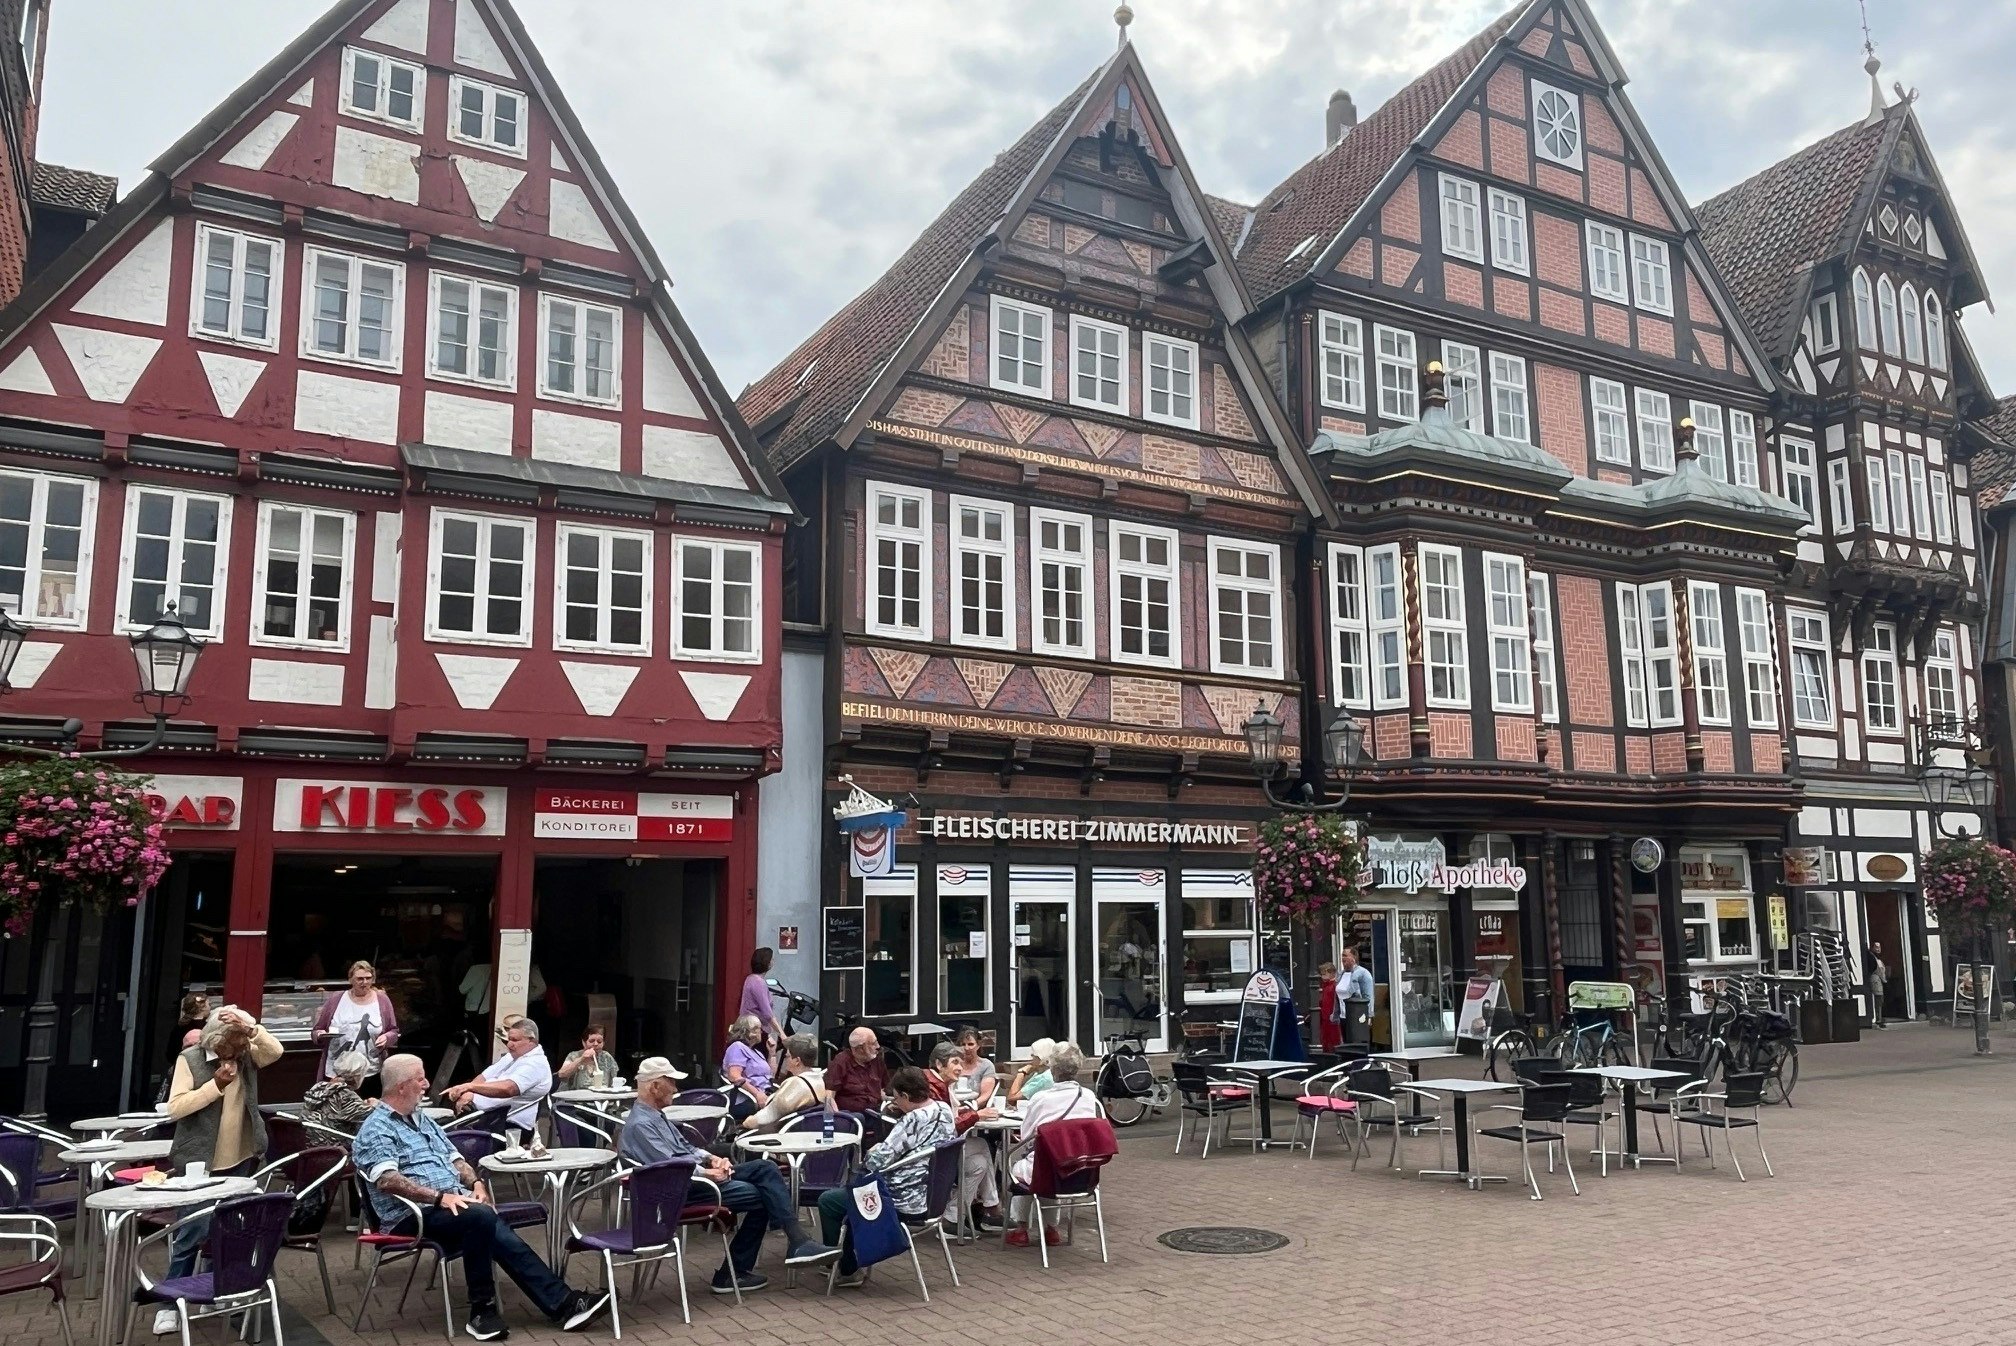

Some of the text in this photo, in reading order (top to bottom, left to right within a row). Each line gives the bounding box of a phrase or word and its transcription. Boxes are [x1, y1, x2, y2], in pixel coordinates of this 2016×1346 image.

[842, 702, 885, 719] BEFIEL
[301, 785, 485, 831] KIESS
[551, 796, 624, 810] BÄCKEREI
[671, 800, 701, 810] SEIT
[541, 820, 631, 833] KONDITOREI
[668, 823, 703, 835] 1871
[933, 815, 1238, 845] FLEISCHEREI ZIMMERMANN
[1377, 860, 1424, 892] hloß
[1432, 860, 1523, 892] Apotheke
[506, 973, 522, 983] TO
